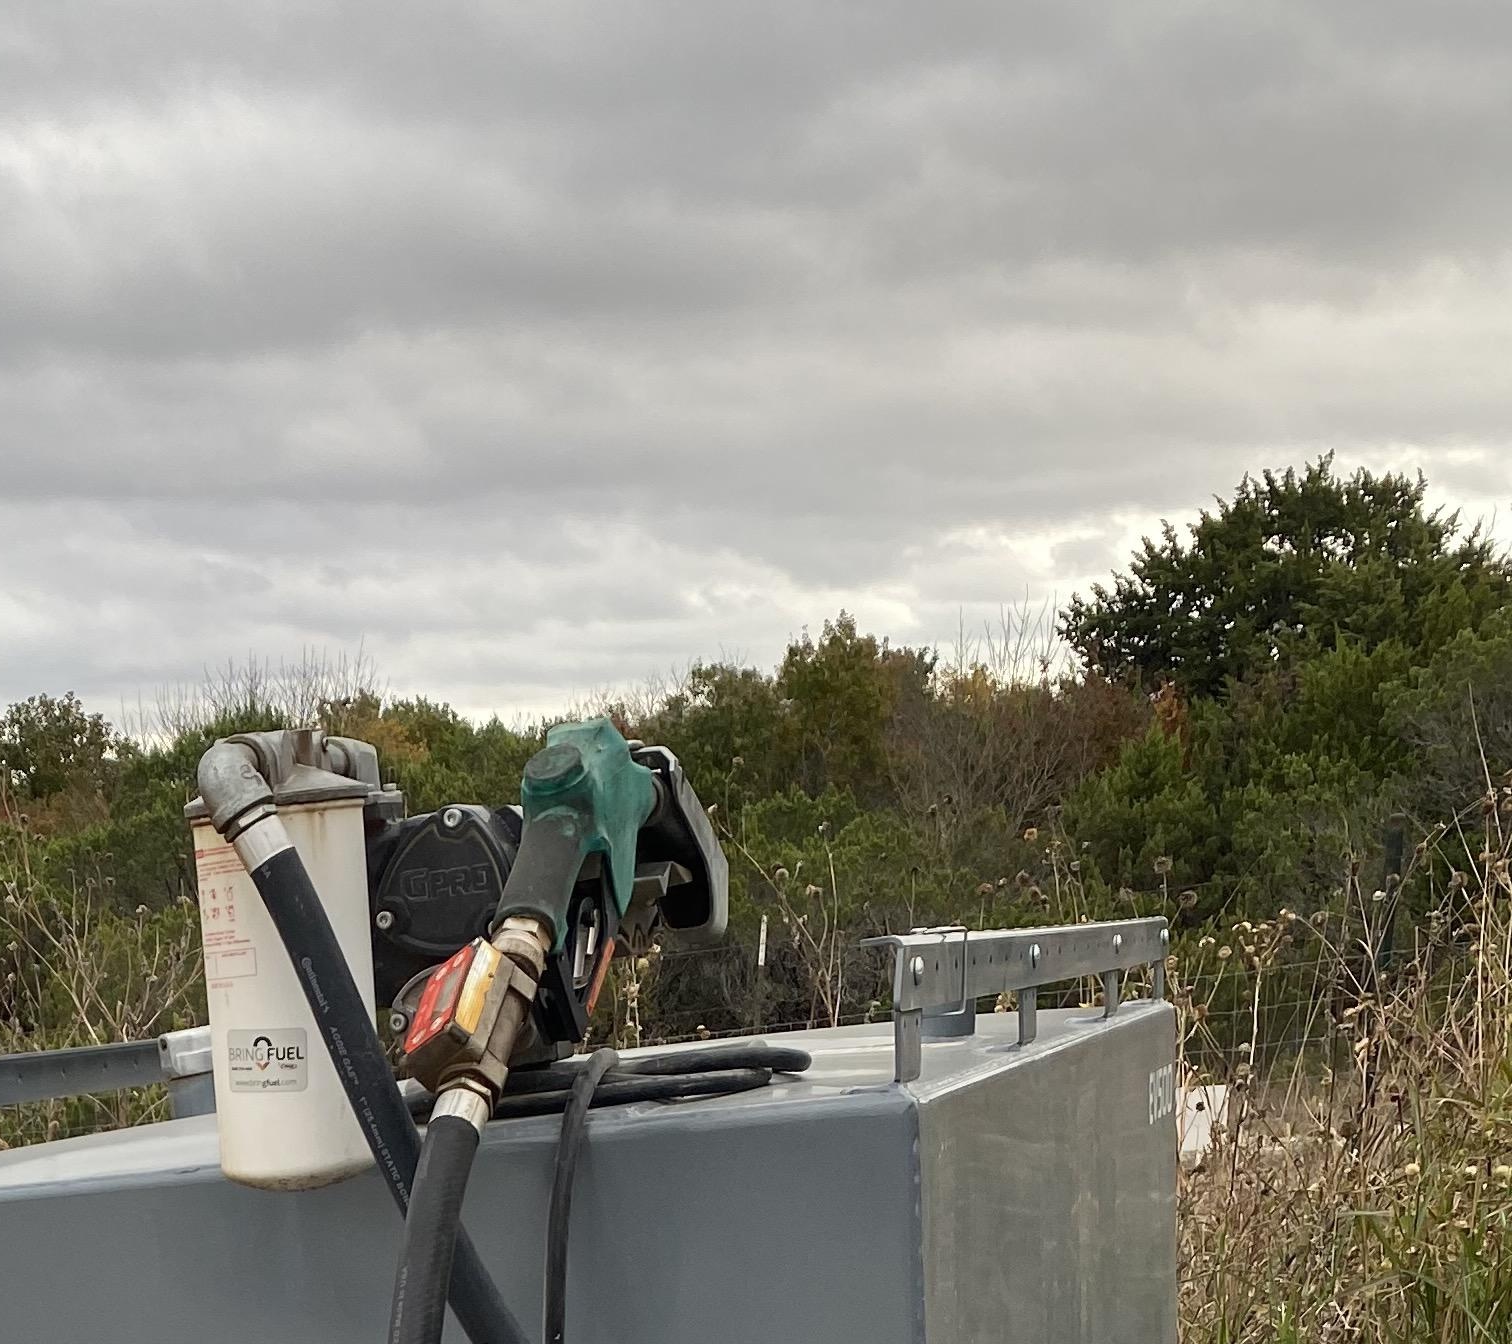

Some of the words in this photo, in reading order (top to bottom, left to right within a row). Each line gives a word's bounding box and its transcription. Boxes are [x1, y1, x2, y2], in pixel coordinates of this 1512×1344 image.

[400, 863, 489, 900] GPRO
[229, 1047, 264, 1061] BRING
[267, 1046, 304, 1060] FUEL
[380, 1148, 401, 1181] STATIC
